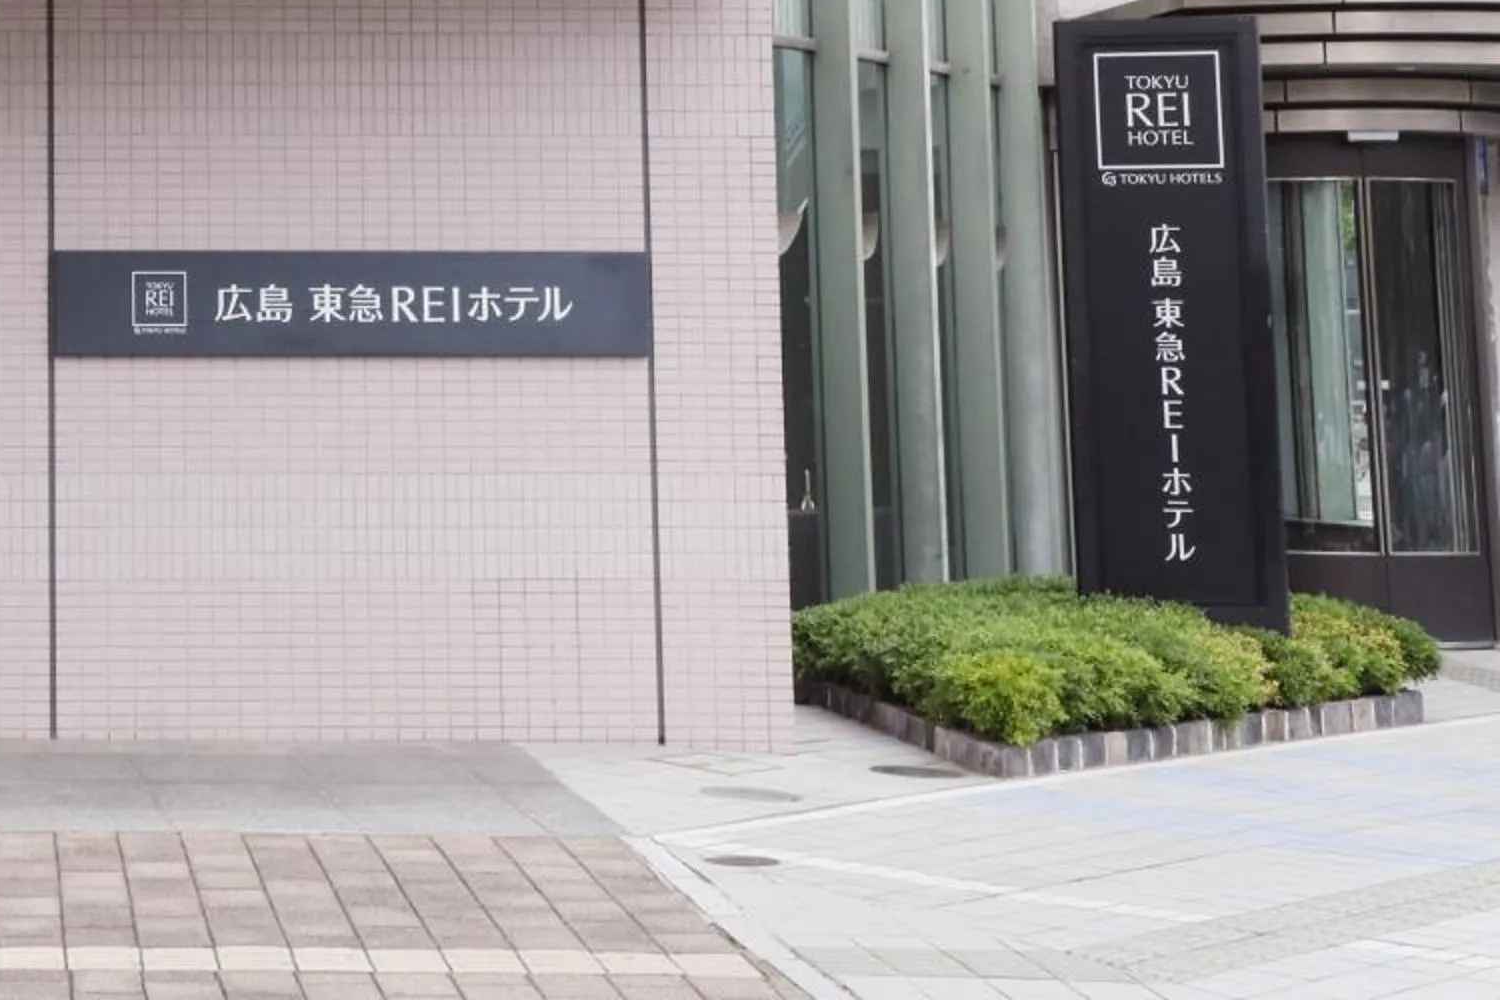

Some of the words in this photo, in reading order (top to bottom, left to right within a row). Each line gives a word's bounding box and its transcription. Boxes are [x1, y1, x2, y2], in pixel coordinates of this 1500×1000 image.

[1124, 75, 1189, 90] TOKYU
[1125, 91, 1191, 128] REI
[1127, 129, 1194, 146] HOTEL
[1119, 173, 1166, 185] TOKYU
[1169, 172, 1223, 185] HOTELS
[1148, 223, 1182, 287] 広島
[145, 289, 175, 307] REI
[214, 283, 293, 323] 広島
[307, 283, 574, 323] 東急REIホテル
[1151, 297, 1196, 562] 東急REIホテル
